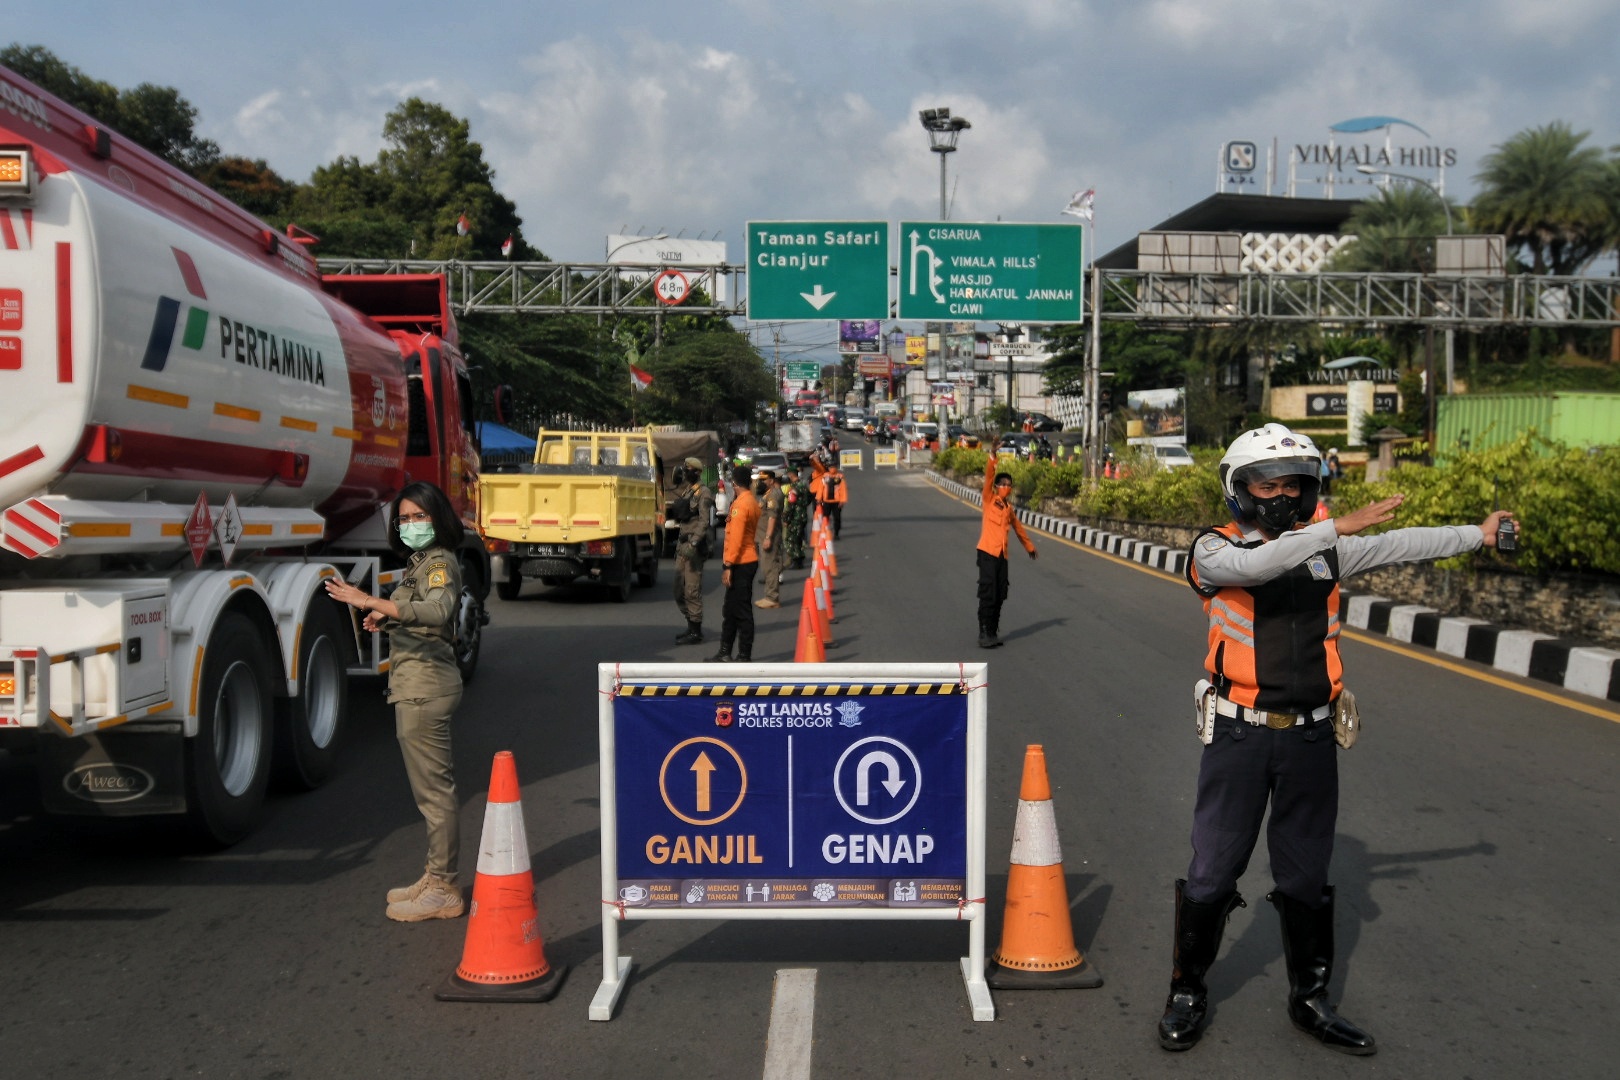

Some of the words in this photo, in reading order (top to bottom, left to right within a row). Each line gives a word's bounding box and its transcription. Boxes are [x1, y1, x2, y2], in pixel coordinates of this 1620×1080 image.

[757, 231, 817, 245] Taman
[824, 231, 880, 245] Safari
[929, 229, 981, 240] CISARUA
[757, 252, 829, 270] Cianjur
[951, 256, 996, 268] VIMALA
[950, 274, 992, 286] MASJID
[950, 288, 1018, 299] HARAKATUL
[1026, 289, 1073, 300] JANNAH
[950, 303, 983, 315] CIAWI
[219, 315, 325, 387] PERTAMINA
[131, 613, 147, 626] TOOL
[149, 610, 162, 623] BOX
[738, 703, 767, 716] SAT
[771, 703, 832, 716] LANTAS
[738, 717, 783, 728] POLRES
[786, 717, 833, 728] BOGOR
[80, 770, 135, 791] Aweco
[645, 834, 763, 865] GANJIL
[821, 834, 934, 864] GENAP
[772, 884, 808, 892] MENJAGA
